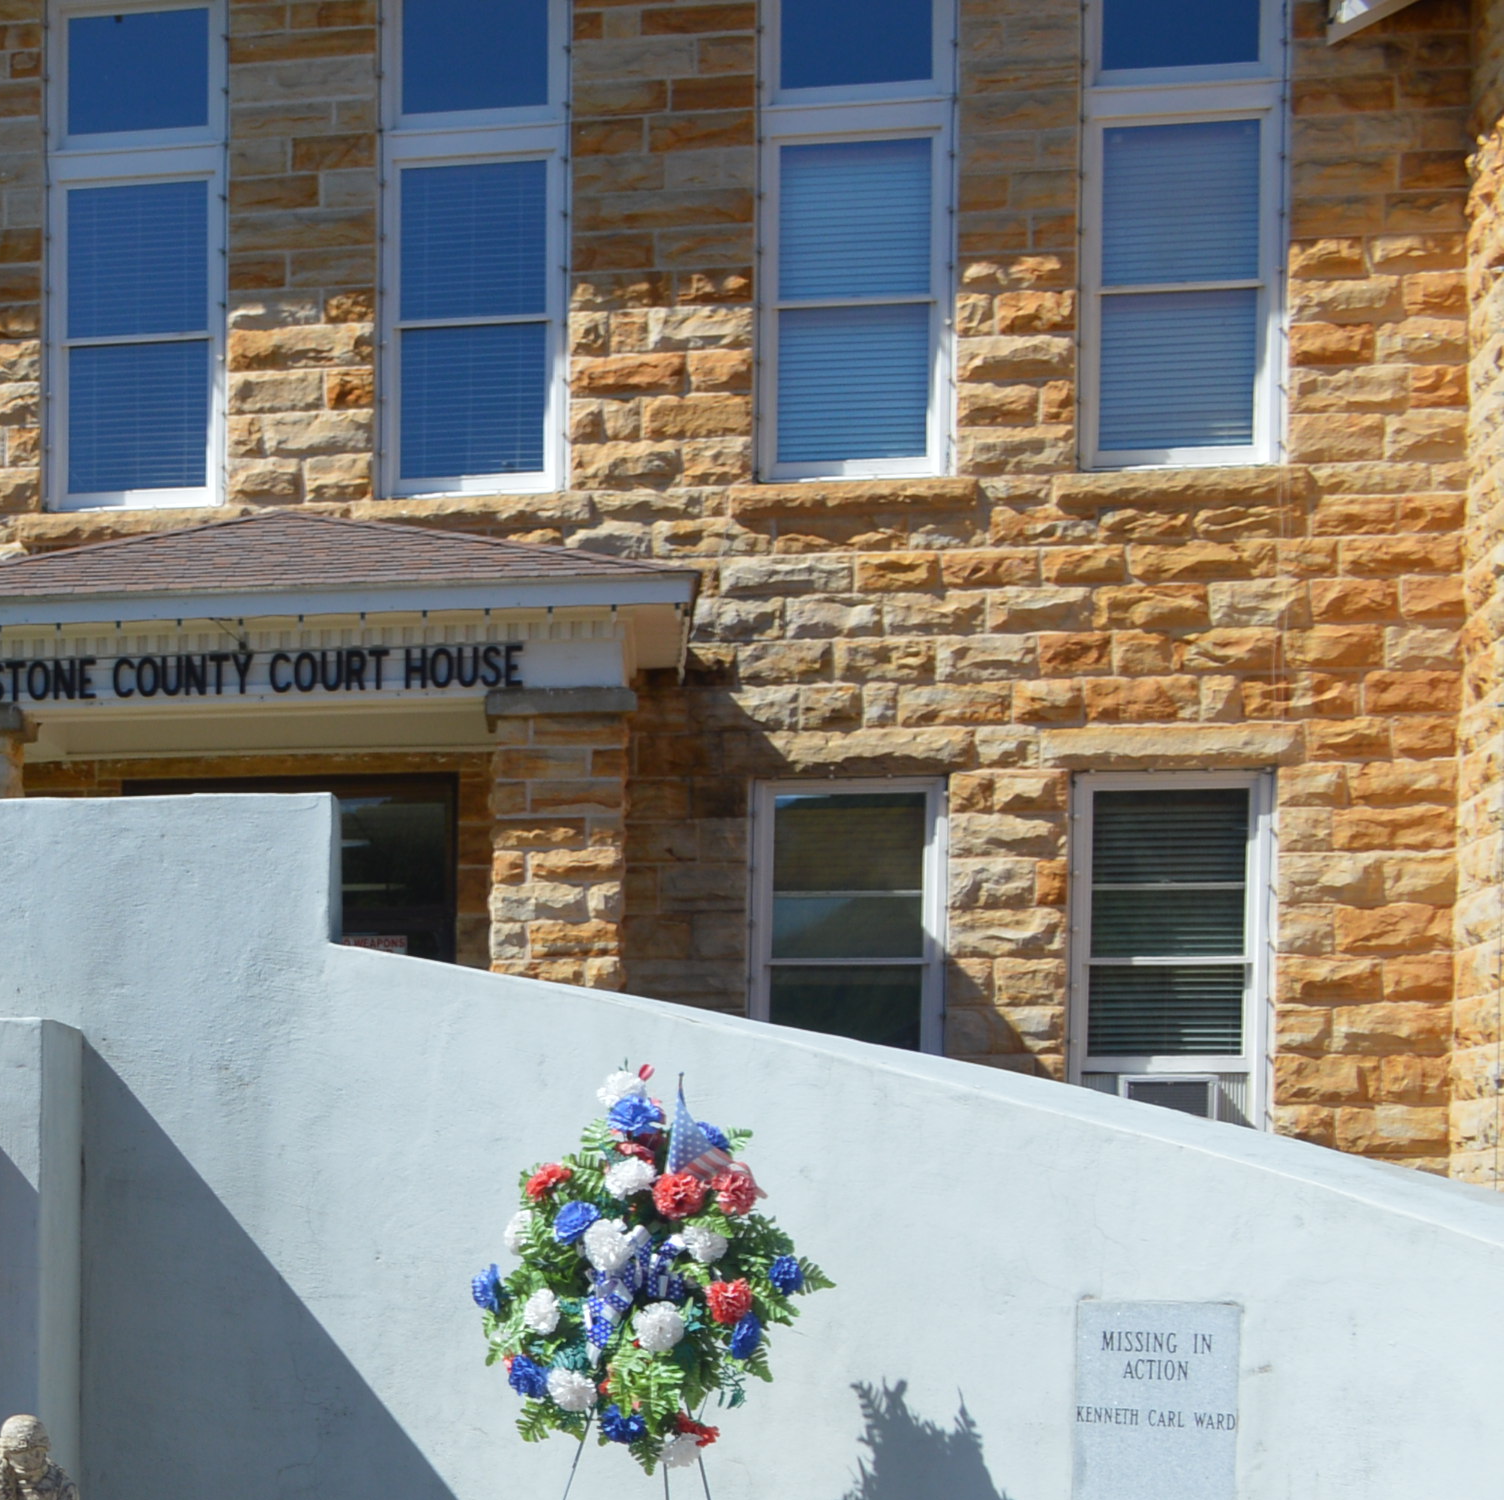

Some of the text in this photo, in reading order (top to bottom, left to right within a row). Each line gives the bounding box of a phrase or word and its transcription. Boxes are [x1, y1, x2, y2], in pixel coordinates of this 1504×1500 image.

[113, 654, 254, 698] COUNTY
[270, 650, 389, 692] COURT
[405, 644, 523, 689] HOUSE
[354, 938, 406, 948] WEAPONS
[1101, 1331, 1213, 1354] MISSING IN
[1123, 1359, 1188, 1380] ACTION
[1076, 1406, 1236, 1431] KENNETH CARL WARD
